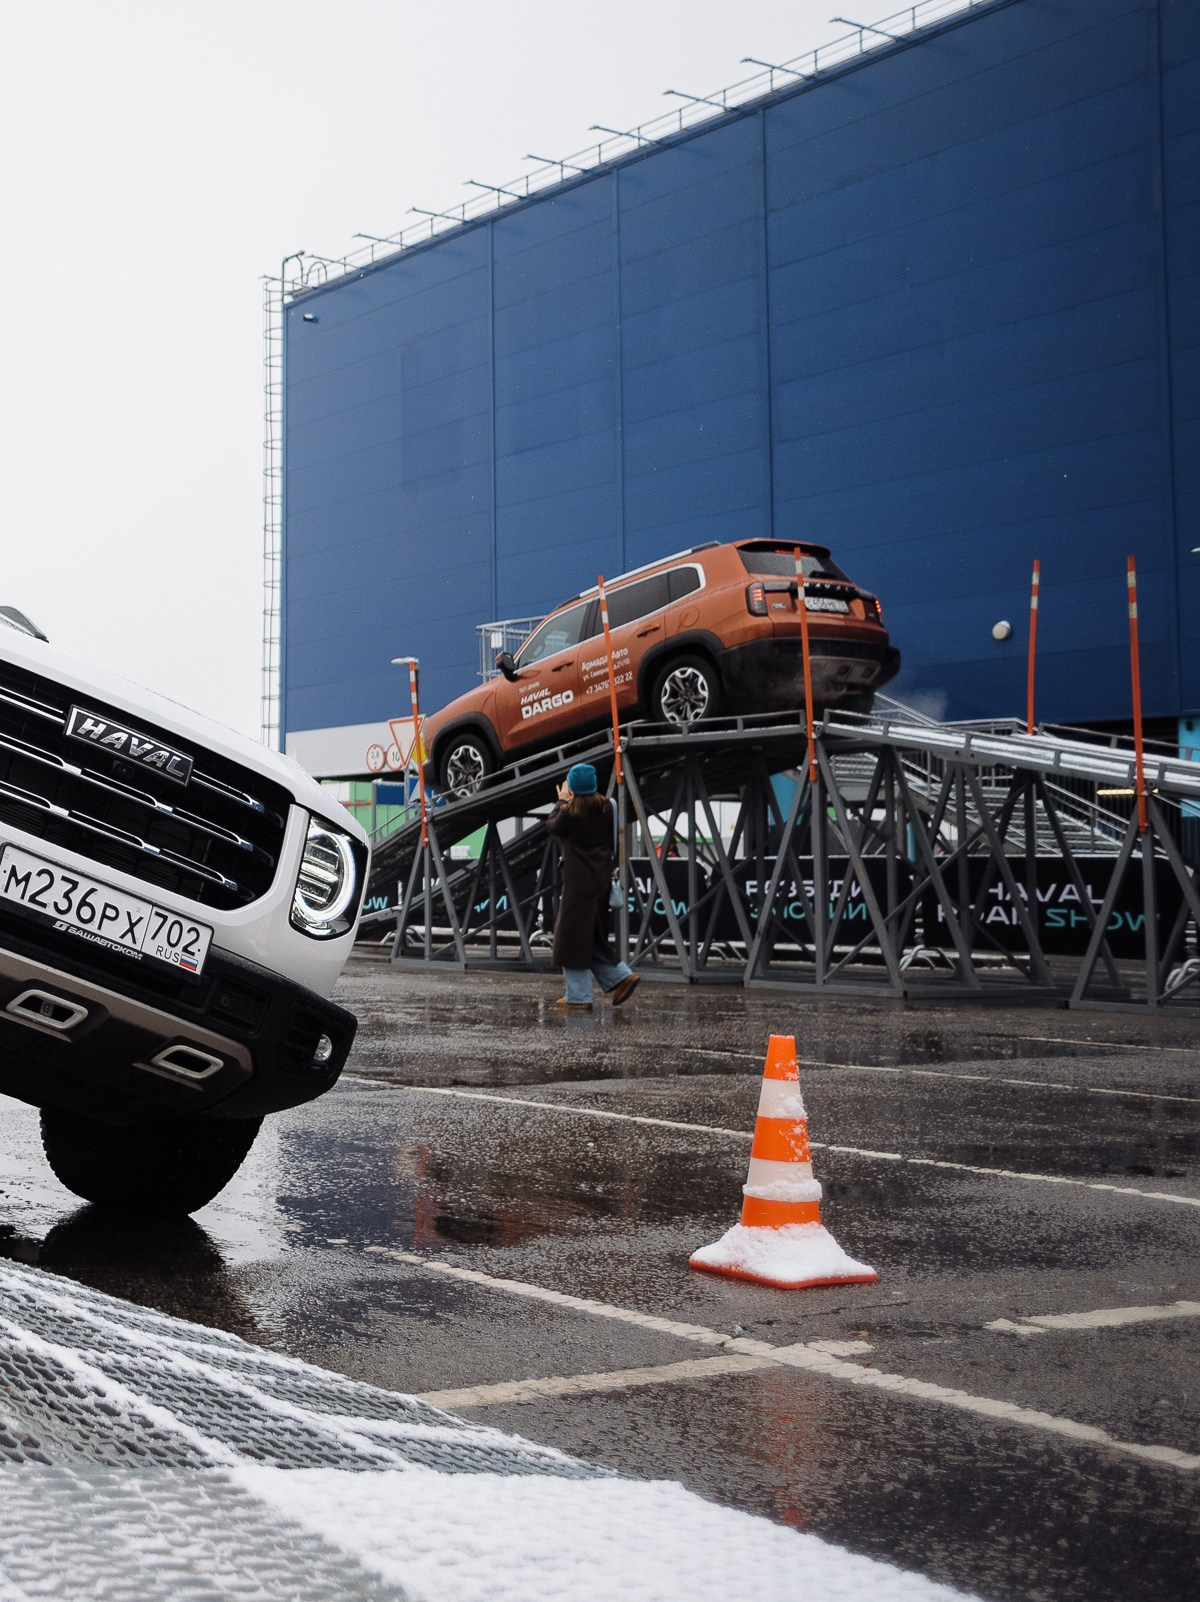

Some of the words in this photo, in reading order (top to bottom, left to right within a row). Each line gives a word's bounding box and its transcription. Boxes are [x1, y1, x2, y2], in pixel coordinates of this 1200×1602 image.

[521, 688, 551, 705] HAVAL
[521, 690, 574, 719] DARGO
[77, 717, 185, 777] HAVAL
[150, 911, 201, 957] 702
[156, 945, 181, 963] RUS
